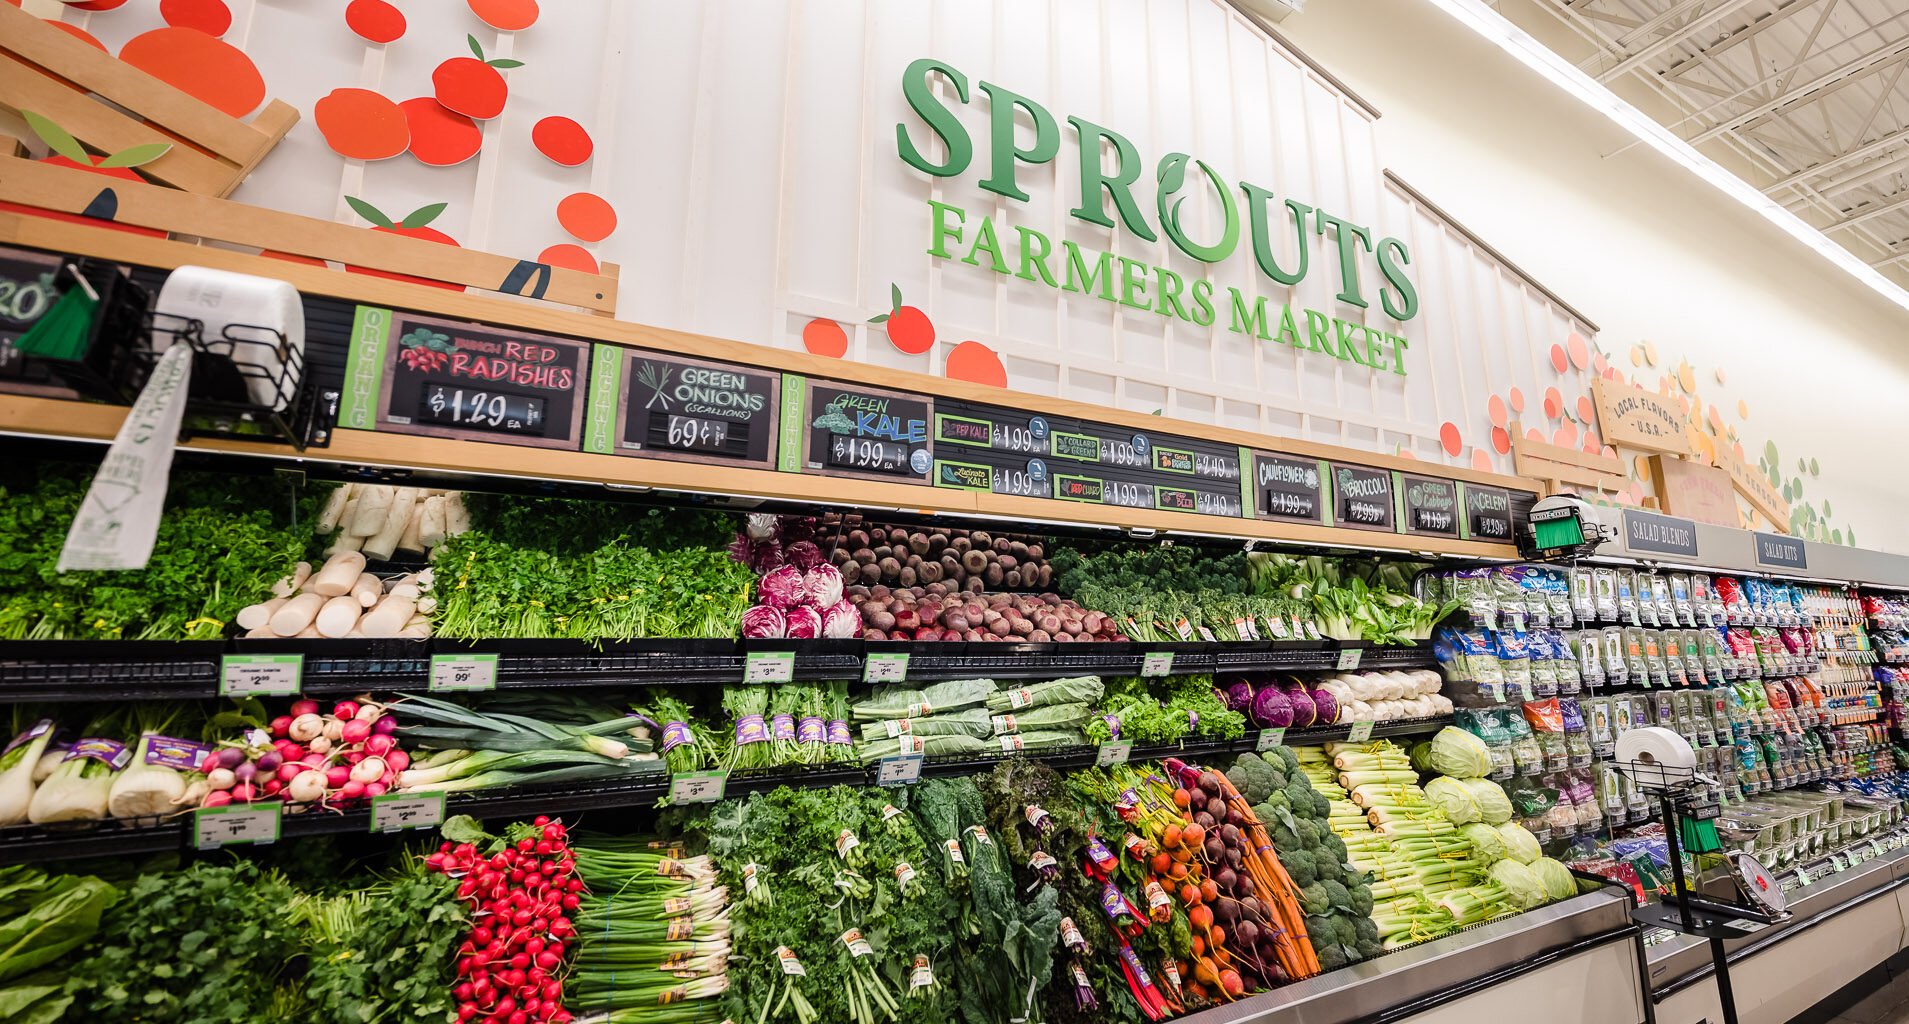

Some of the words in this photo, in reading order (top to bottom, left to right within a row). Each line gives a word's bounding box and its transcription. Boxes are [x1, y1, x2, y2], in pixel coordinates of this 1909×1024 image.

[896, 58, 1418, 321] SPROUTS
[927, 200, 1216, 326] FARMERS
[1228, 286, 1409, 376] MARKET
[505, 340, 560, 363] RED
[349, 309, 382, 428] ORGANIC
[450, 352, 573, 391] RADISHES
[680, 368, 746, 391] GREEN
[429, 387, 507, 427] $1.29
[507, 419, 521, 428] EA
[592, 346, 615, 452] ORGANIC
[674, 384, 766, 411] ONIONS
[684, 402, 752, 420] (SCALLIONS)
[833, 393, 889, 413] GREEN
[785, 376, 799, 471] ORGANIC
[856, 410, 928, 443] KALE
[1613, 396, 1639, 419] LOCAL
[1640, 397, 1679, 433] FLAVORS
[668, 416, 710, 448] 69¢
[956, 424, 969, 436] RED
[969, 425, 989, 439] KALE
[993, 424, 1032, 452] $1.99
[1067, 437, 1096, 448] COLLARD
[835, 438, 884, 468] $1.99
[884, 461, 893, 469] EA
[1071, 446, 1096, 458] GREENS
[1101, 441, 1135, 466] $1.99
[1174, 453, 1188, 461] Gold
[967, 475, 988, 488] KALE
[993, 468, 1032, 495] $1.99
[1104, 482, 1138, 506] $1.99
[1348, 477, 1387, 498] BROCCOLI
[1422, 482, 1447, 495] GREEN
[1745, 473, 1777, 511] SEASON
[1478, 492, 1507, 511] CELERY
[1632, 520, 1659, 541] SALAD
[1660, 525, 1690, 547] BLENDS
[1764, 541, 1784, 559] SALAD
[1784, 546, 1798, 561] KITS
